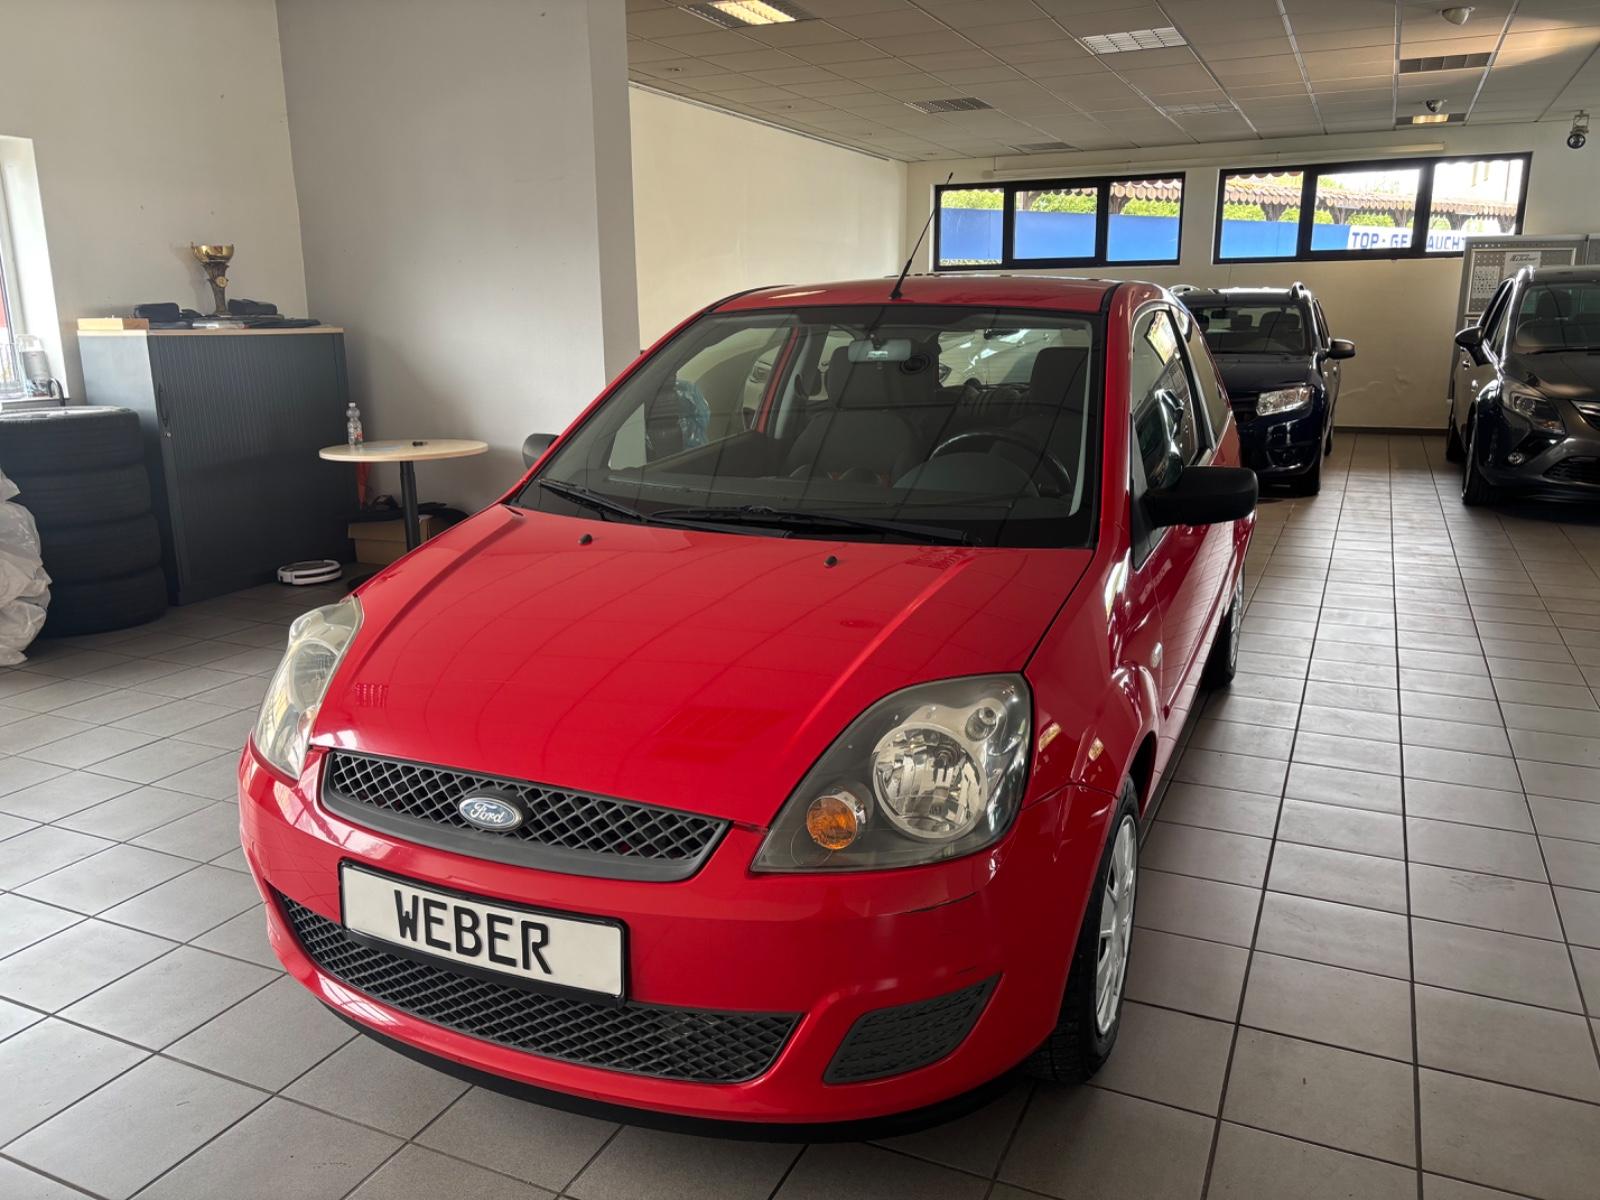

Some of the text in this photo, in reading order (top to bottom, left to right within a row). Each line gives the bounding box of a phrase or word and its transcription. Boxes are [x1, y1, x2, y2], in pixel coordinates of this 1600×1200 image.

[1351, 231, 1380, 249] TOP
[470, 802, 506, 823] Ford
[394, 889, 552, 975] WEBER
